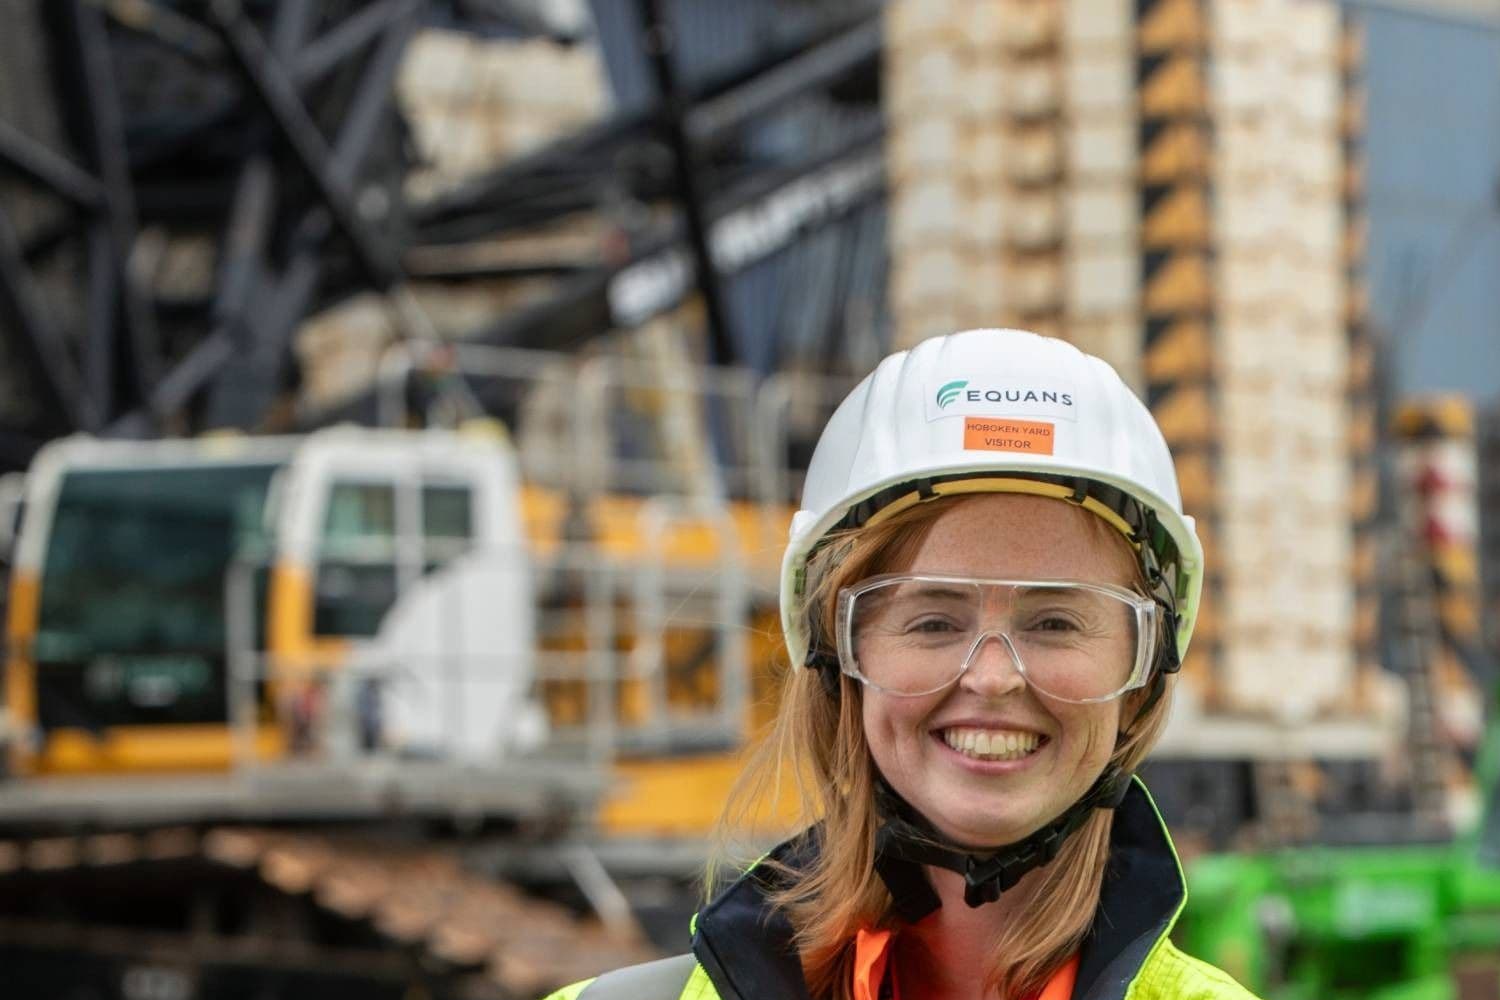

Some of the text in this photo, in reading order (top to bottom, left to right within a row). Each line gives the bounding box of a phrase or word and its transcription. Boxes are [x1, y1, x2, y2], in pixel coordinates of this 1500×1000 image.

[967, 390, 1073, 406] EQUANS
[967, 423, 1050, 436] HOBOKEN YARD
[985, 438, 1032, 448] VISITOR
